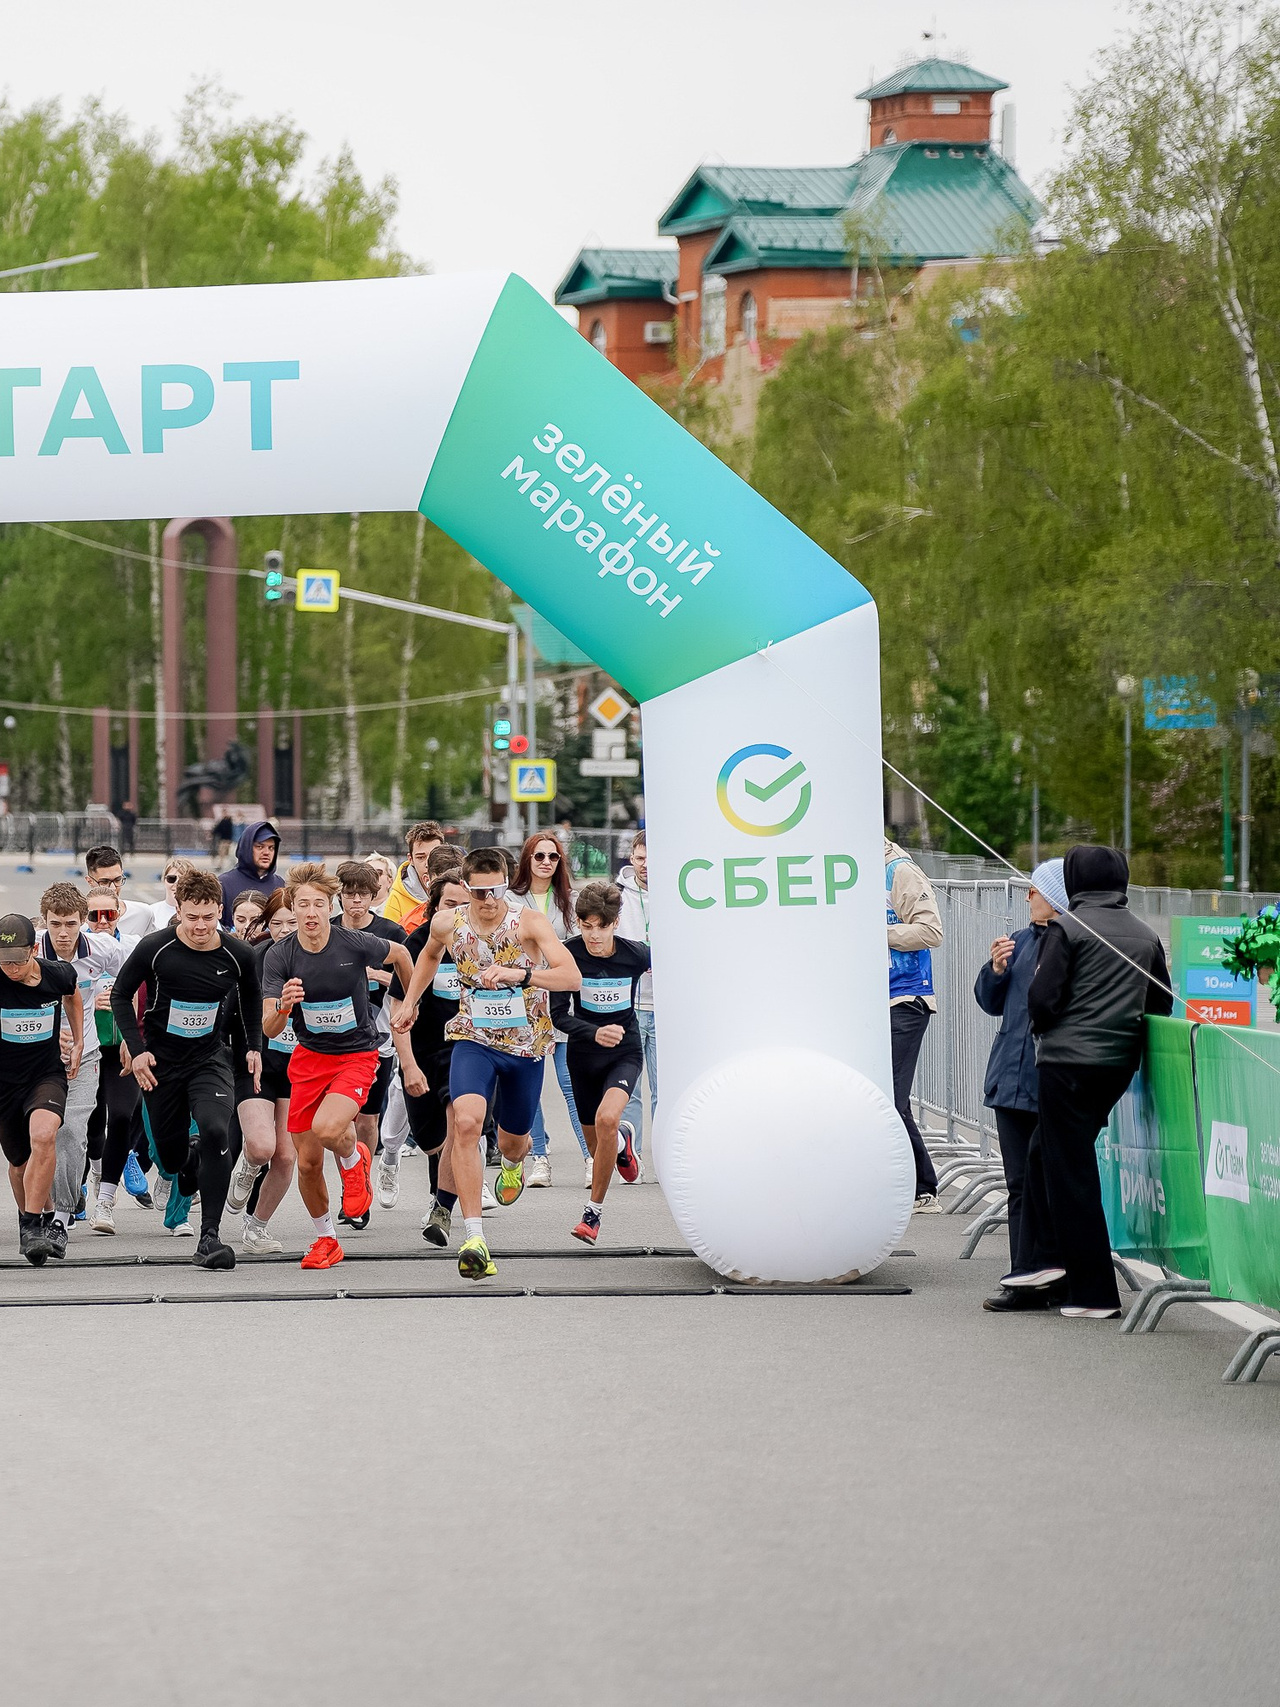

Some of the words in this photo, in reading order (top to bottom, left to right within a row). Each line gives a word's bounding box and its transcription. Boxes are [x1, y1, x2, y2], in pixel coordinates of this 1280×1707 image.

[532, 423, 722, 586] зелёный
[500, 454, 683, 619] марафон
[678, 854, 859, 910] СБЕР
[592, 992, 620, 1002] 3365
[484, 1005, 512, 1016] 3355
[182, 1016, 208, 1027] 3332
[315, 1014, 342, 1024] 3347
[15, 1022, 43, 1033] 3359
